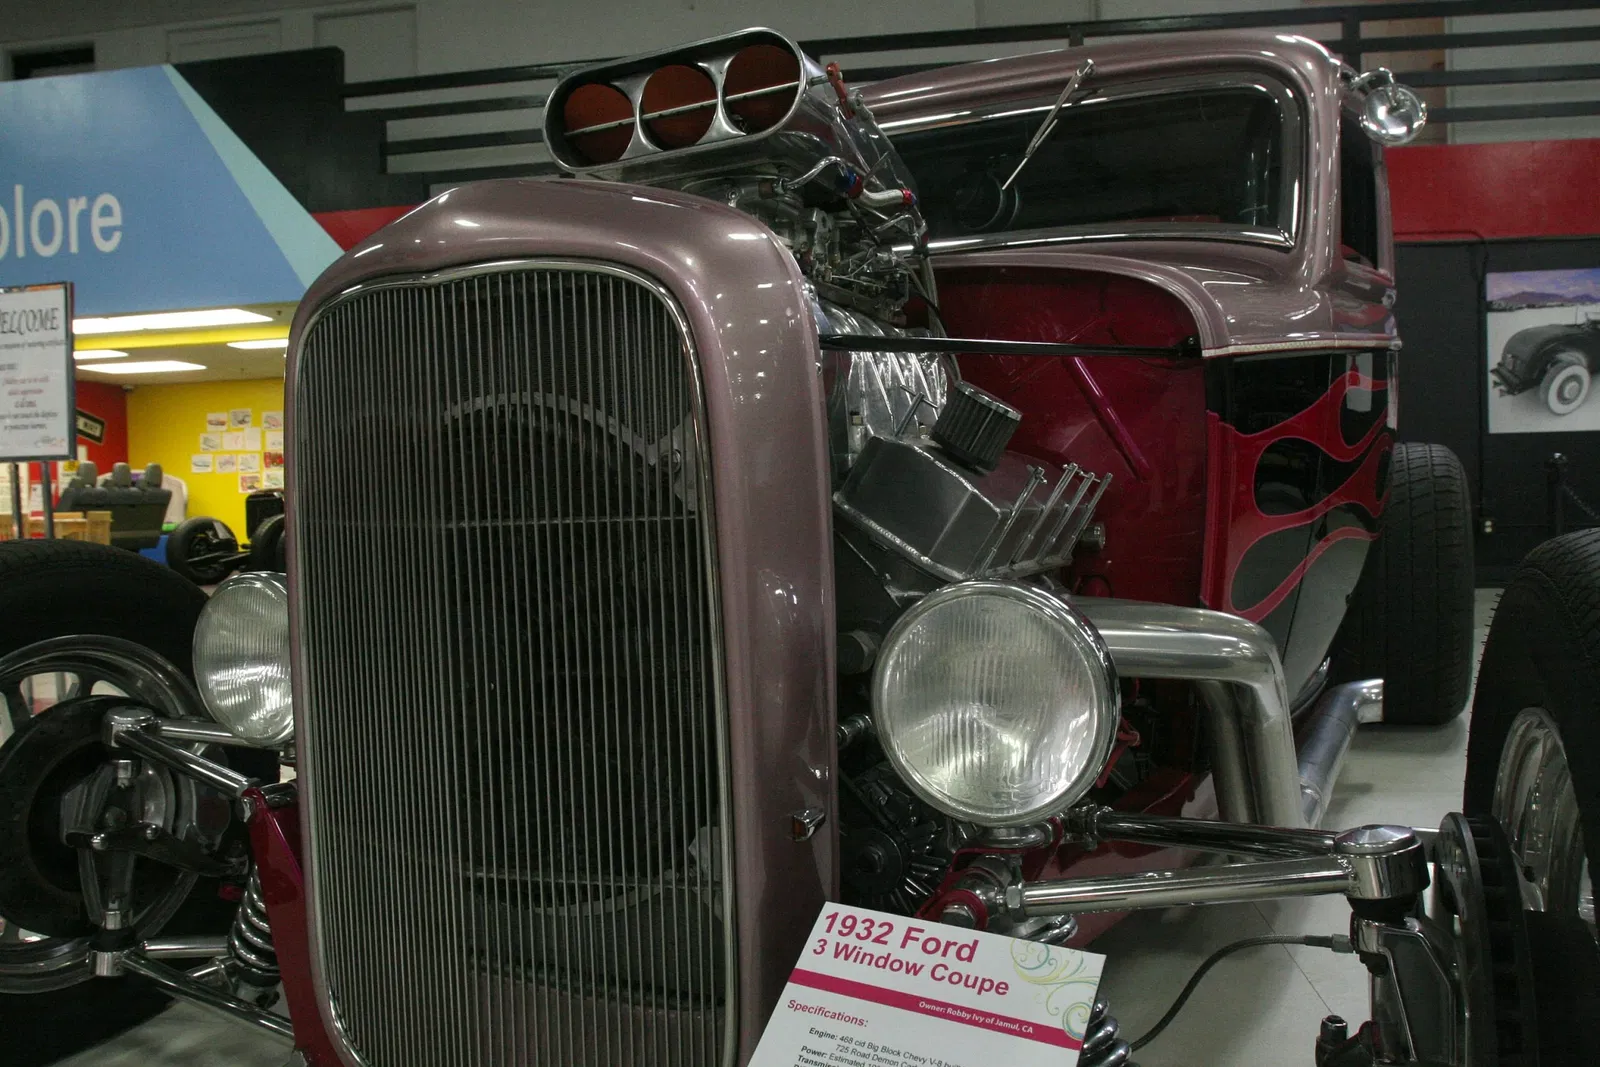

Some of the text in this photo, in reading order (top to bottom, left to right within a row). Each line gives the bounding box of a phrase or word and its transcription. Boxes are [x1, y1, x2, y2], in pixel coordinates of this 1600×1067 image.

[0, 307, 60, 336] ELCOME
[825, 912, 979, 963] 1932 Ford
[813, 938, 1009, 996] 3 Window Coupe
[787, 1000, 869, 1028] Specifications:
[919, 1001, 1033, 1034] Owner: Robby Ivy of Jamul, CA
[801, 1045, 866, 1067] Power: Estimated
[809, 1027, 838, 1040] Engine:
[839, 1036, 854, 1044] 468
[867, 1042, 879, 1052] Big
[880, 1045, 902, 1057] Block
[903, 1051, 927, 1065] Chevy
[929, 1057, 943, 1067] V-8
[835, 1044, 850, 1053] 725
[850, 1048, 871, 1059] Road
[872, 1054, 899, 1066] Demon
